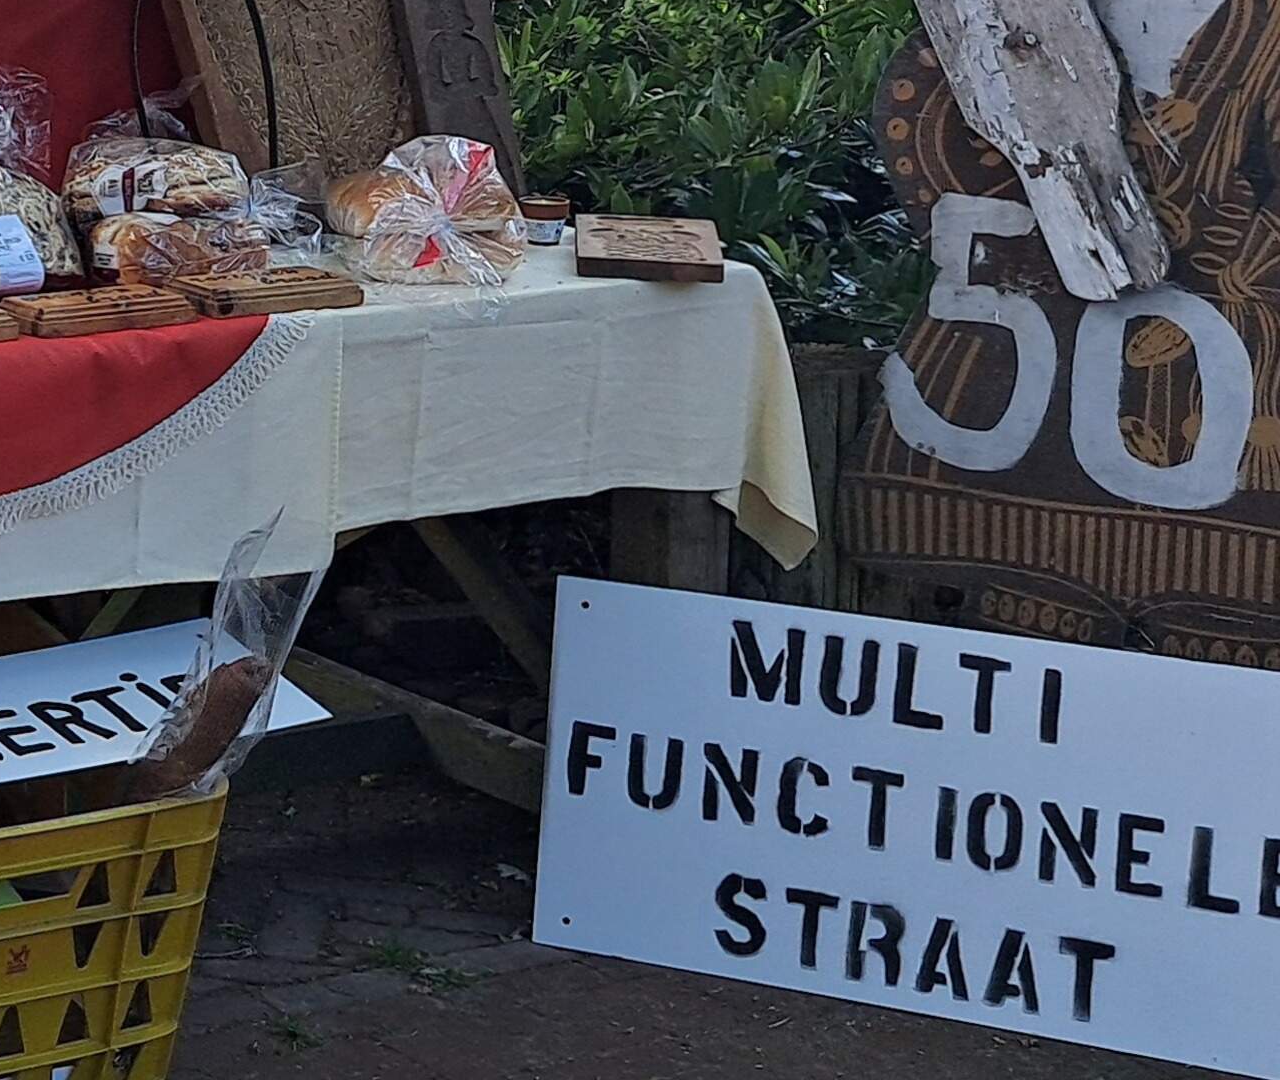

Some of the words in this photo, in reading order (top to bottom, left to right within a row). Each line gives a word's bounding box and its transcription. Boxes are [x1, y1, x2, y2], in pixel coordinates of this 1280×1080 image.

[876, 192, 1254, 511] 50
[730, 619, 1062, 744] MULTI
[713, 872, 1115, 1022] STRAAT
